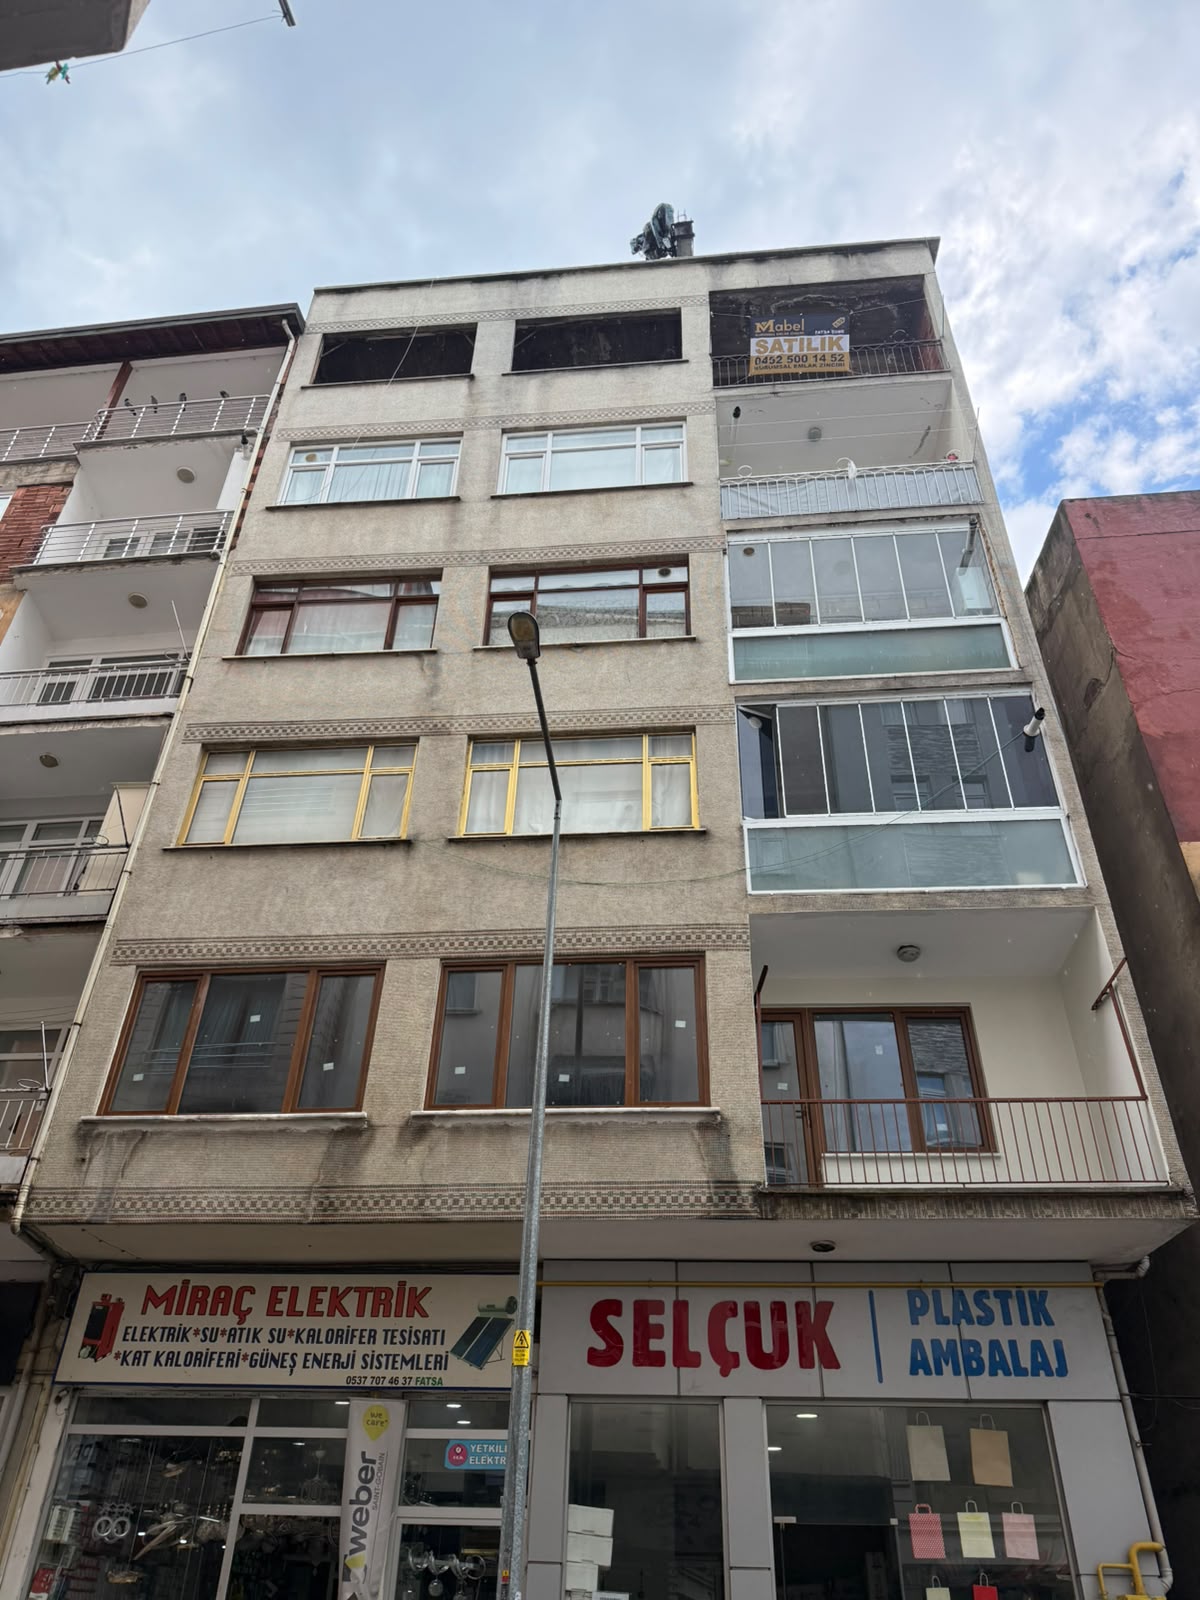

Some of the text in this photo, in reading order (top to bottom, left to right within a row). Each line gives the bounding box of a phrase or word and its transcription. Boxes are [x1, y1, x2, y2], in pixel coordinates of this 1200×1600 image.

[754, 318, 805, 333] Mabel
[755, 336, 844, 355] SATILIK
[755, 354, 845, 365] 0452 500 14 52
[141, 1279, 432, 1325] MİRAÇ ELEKTRİK
[383, 1326, 445, 1345] TESİSATI
[587, 1299, 841, 1377] SELÇUK
[302, 1350, 356, 1369] ENERJİ
[361, 1350, 449, 1371] SİSTEMLERİ
[908, 1338, 1069, 1377] AMBALAJ
[345, 1376, 444, 1386] 0537 707 46 37 FATSA
[469, 1456, 507, 1465] ELEKTR
[372, 1452, 385, 1510] SAINT-GOBAIN
[349, 1451, 377, 1556] weber
